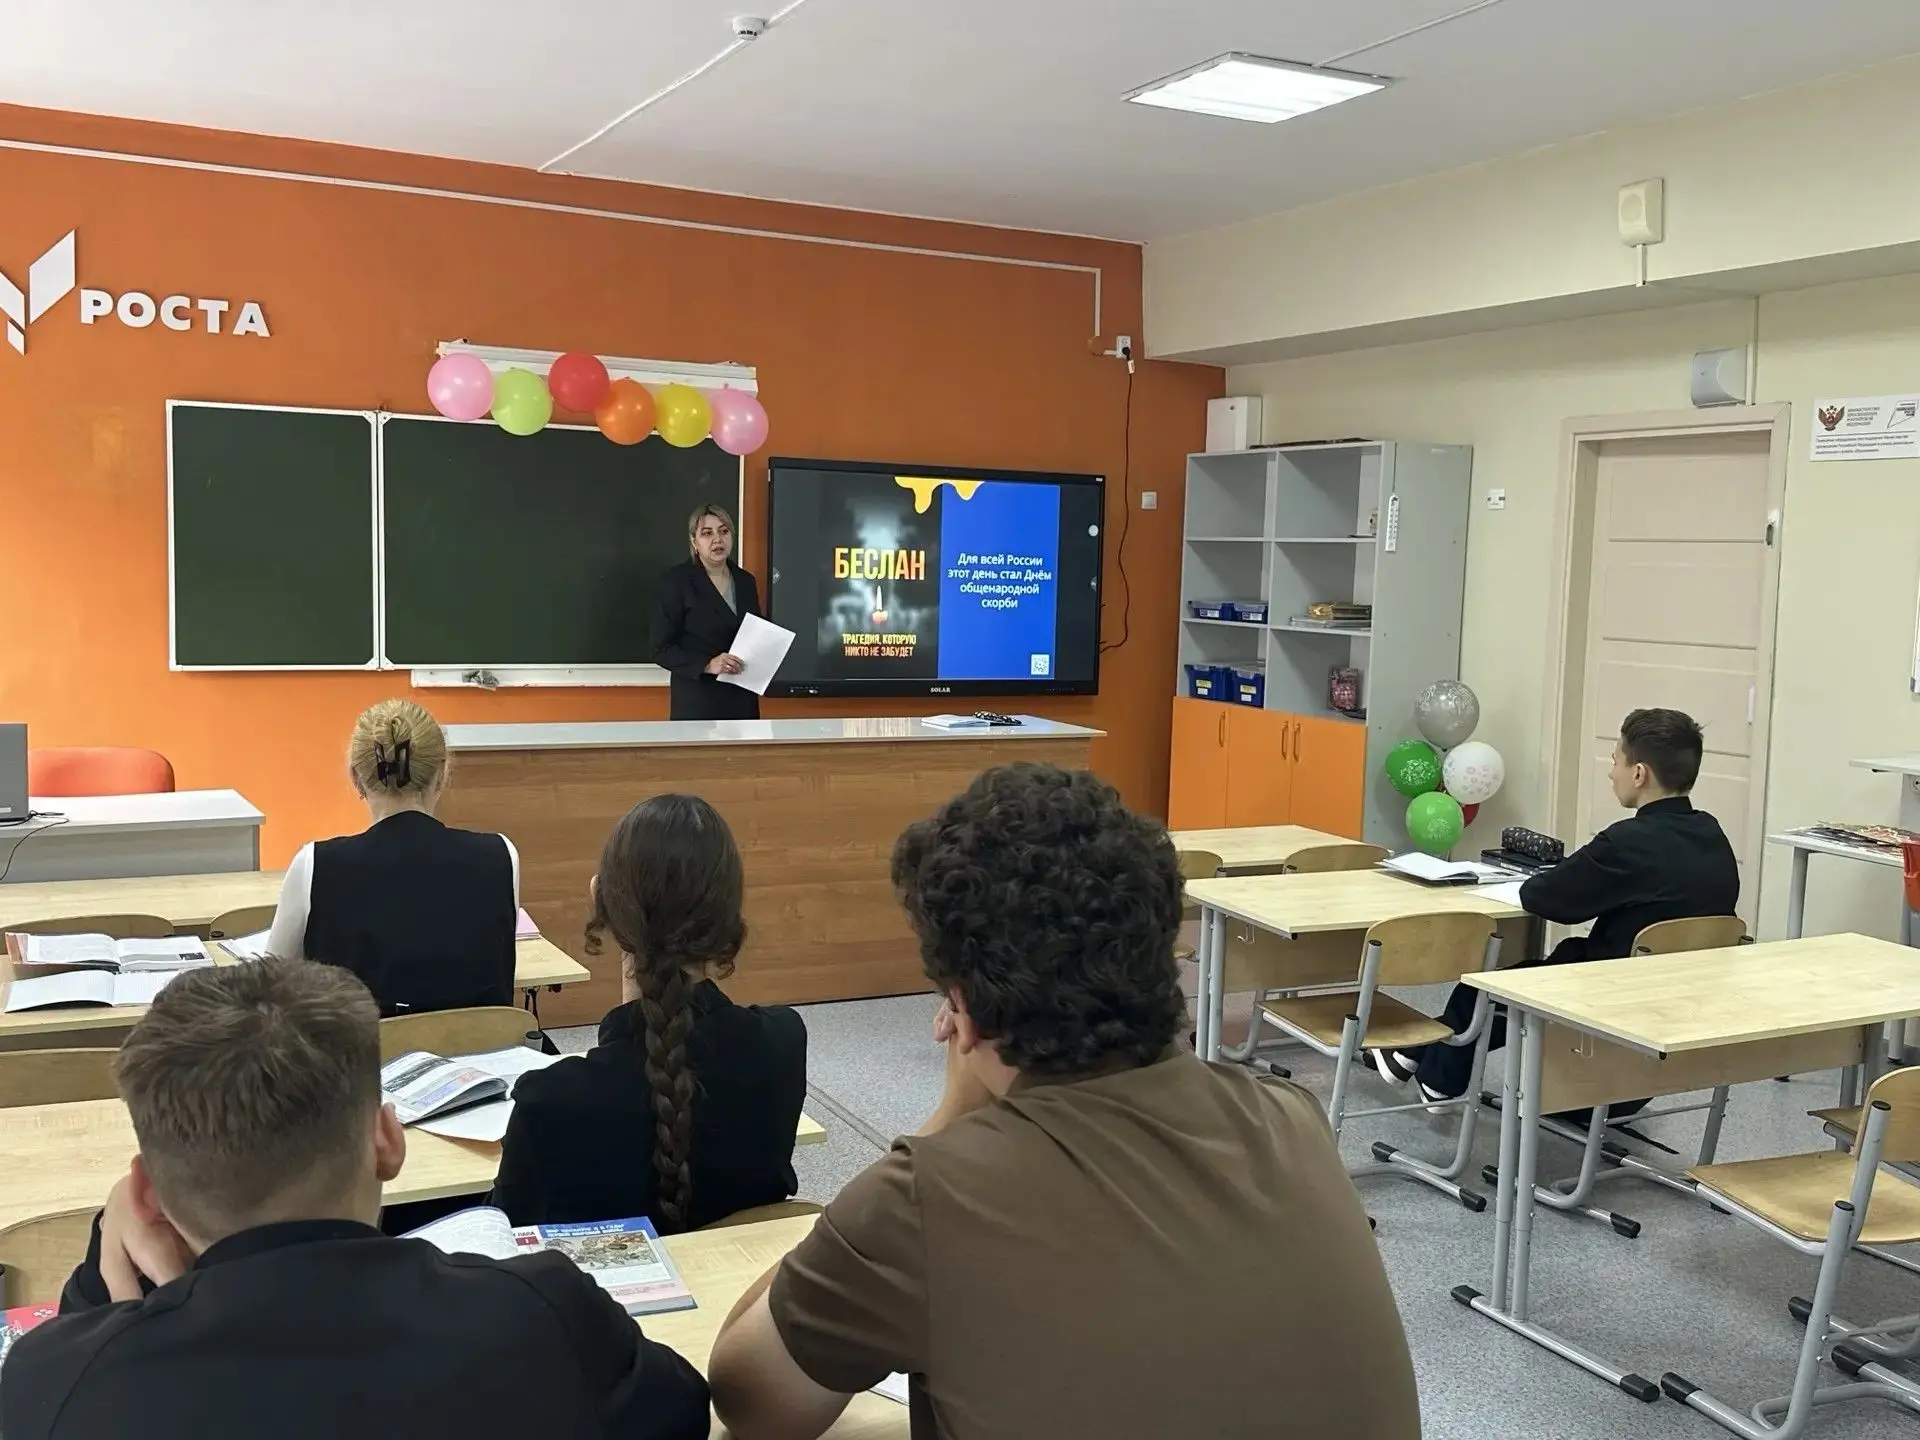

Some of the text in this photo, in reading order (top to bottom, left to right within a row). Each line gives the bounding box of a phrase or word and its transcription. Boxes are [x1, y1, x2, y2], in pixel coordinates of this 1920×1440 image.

[80, 288, 271, 337] РОСТА
[834, 547, 925, 580] БЕСЛАН
[957, 552, 1043, 566] Для всей России
[947, 569, 1052, 582] этот день стал Днём
[960, 582, 1040, 596] общенародной
[981, 597, 1019, 610] скорби
[842, 633, 917, 645] ТРАГЕДИЯ, КОТОРУЮ
[844, 646, 914, 658] НИКТО НЕ ЗАБУДЕТ
